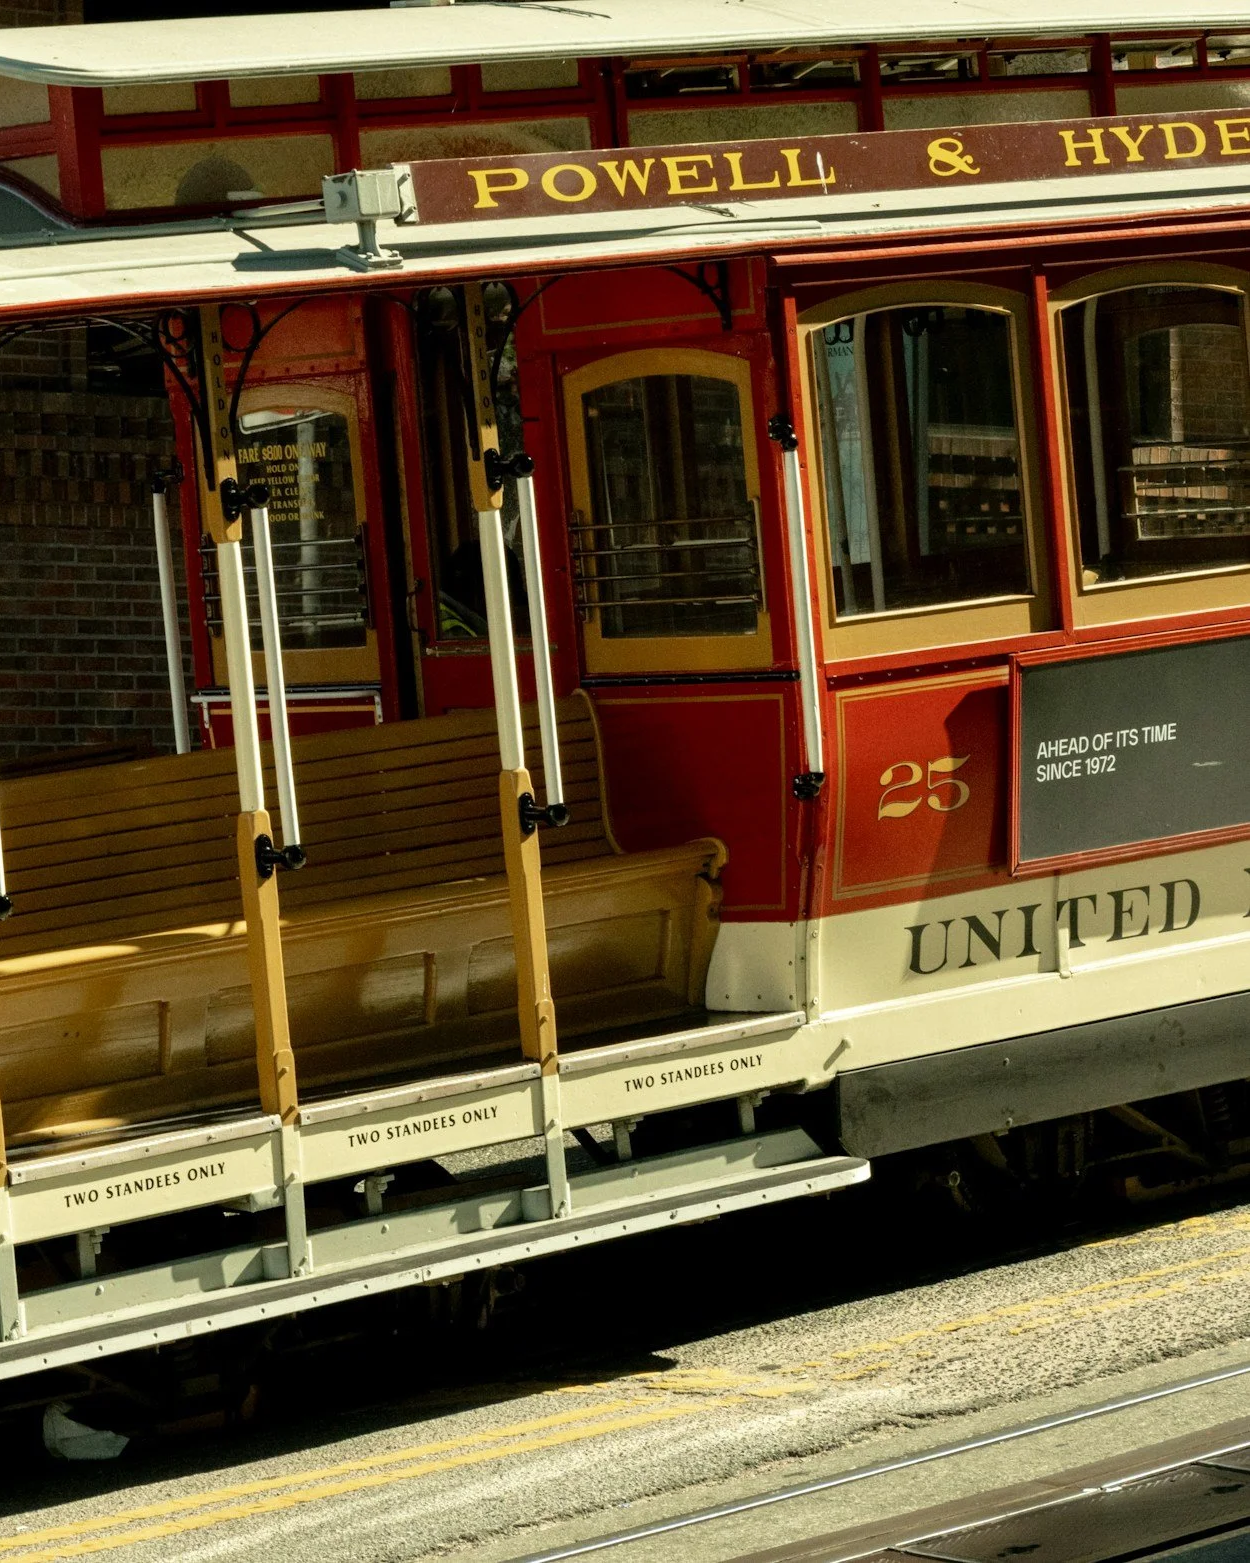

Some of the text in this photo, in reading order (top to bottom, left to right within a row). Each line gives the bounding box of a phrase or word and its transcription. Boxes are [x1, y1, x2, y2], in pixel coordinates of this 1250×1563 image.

[468, 118, 1250, 209] POWELL & HYDE
[474, 304, 486, 380] HOLD
[211, 331, 230, 460] HOLD ON
[237, 448, 260, 464] FARE
[307, 442, 327, 458] WAY
[266, 463, 300, 474] HOLD ON
[249, 477, 266, 486] KEEP
[267, 475, 295, 485] YELLOW
[272, 487, 282, 497] EA
[269, 513, 287, 522] OOD
[288, 512, 300, 521] OR
[1036, 722, 1178, 760] AHEAD OF ITS TIME
[877, 753, 971, 821] 25
[1035, 755, 1116, 783] SINCE 1972
[904, 878, 1202, 975] UNITED
[624, 1054, 764, 1093] TWO STANDEES ONLY
[348, 1105, 499, 1148] TWO STANDEES ONLY
[64, 1161, 226, 1209] TWO STANDEES ONLY
